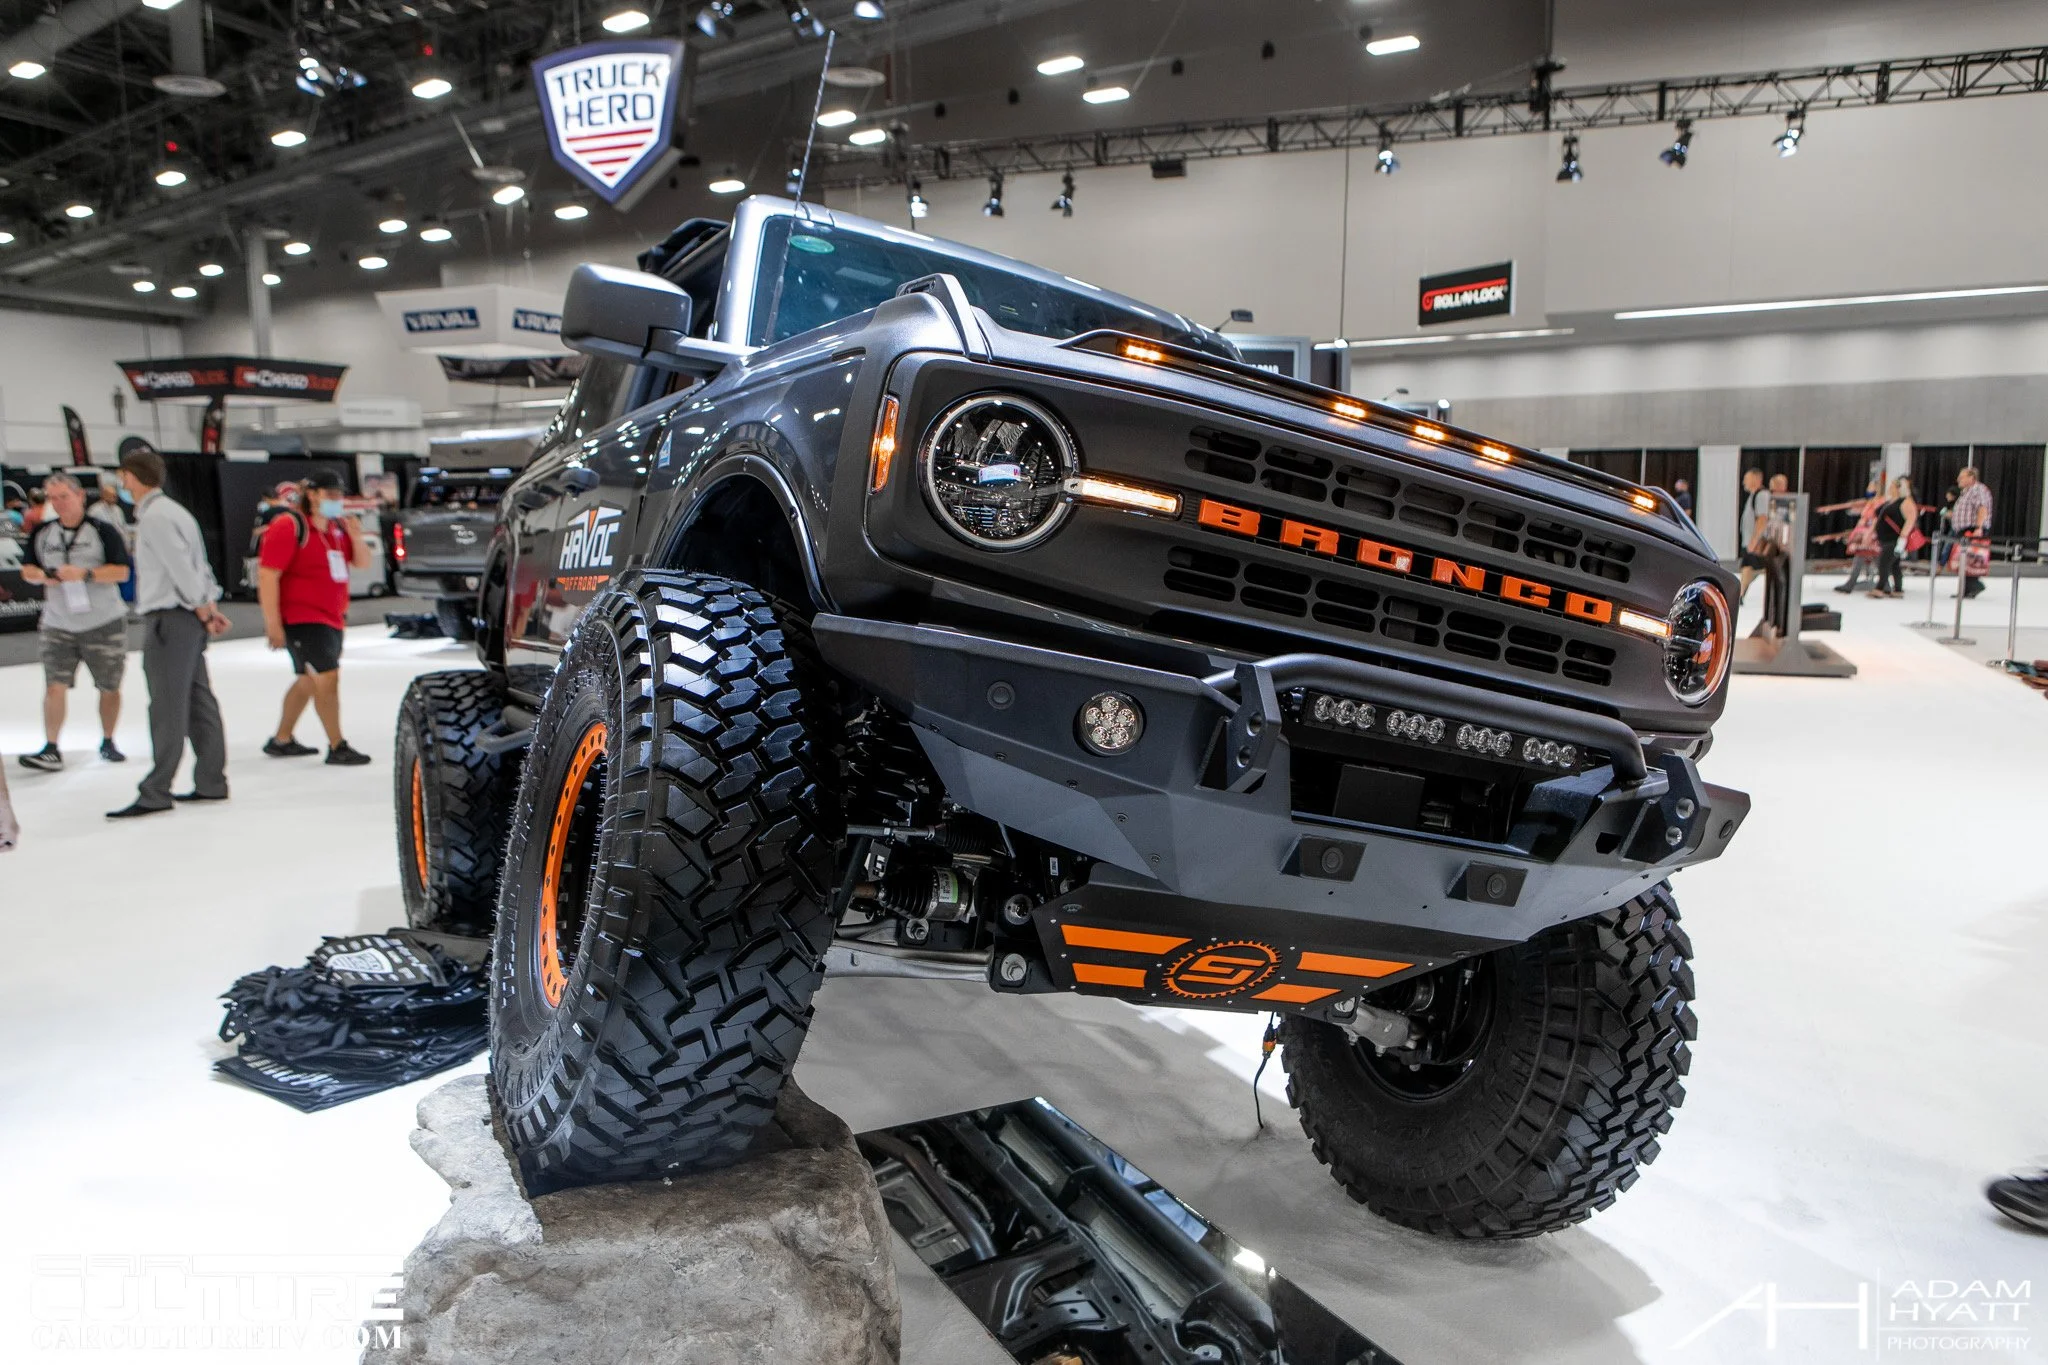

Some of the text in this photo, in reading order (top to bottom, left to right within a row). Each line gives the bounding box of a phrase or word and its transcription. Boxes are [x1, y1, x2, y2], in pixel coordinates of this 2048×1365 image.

[554, 61, 662, 97] TRUCK
[564, 93, 655, 130] HERO
[559, 506, 623, 570] HAVOC
[1198, 498, 1613, 624] BRONCO
[564, 576, 598, 591] OFFROAD
